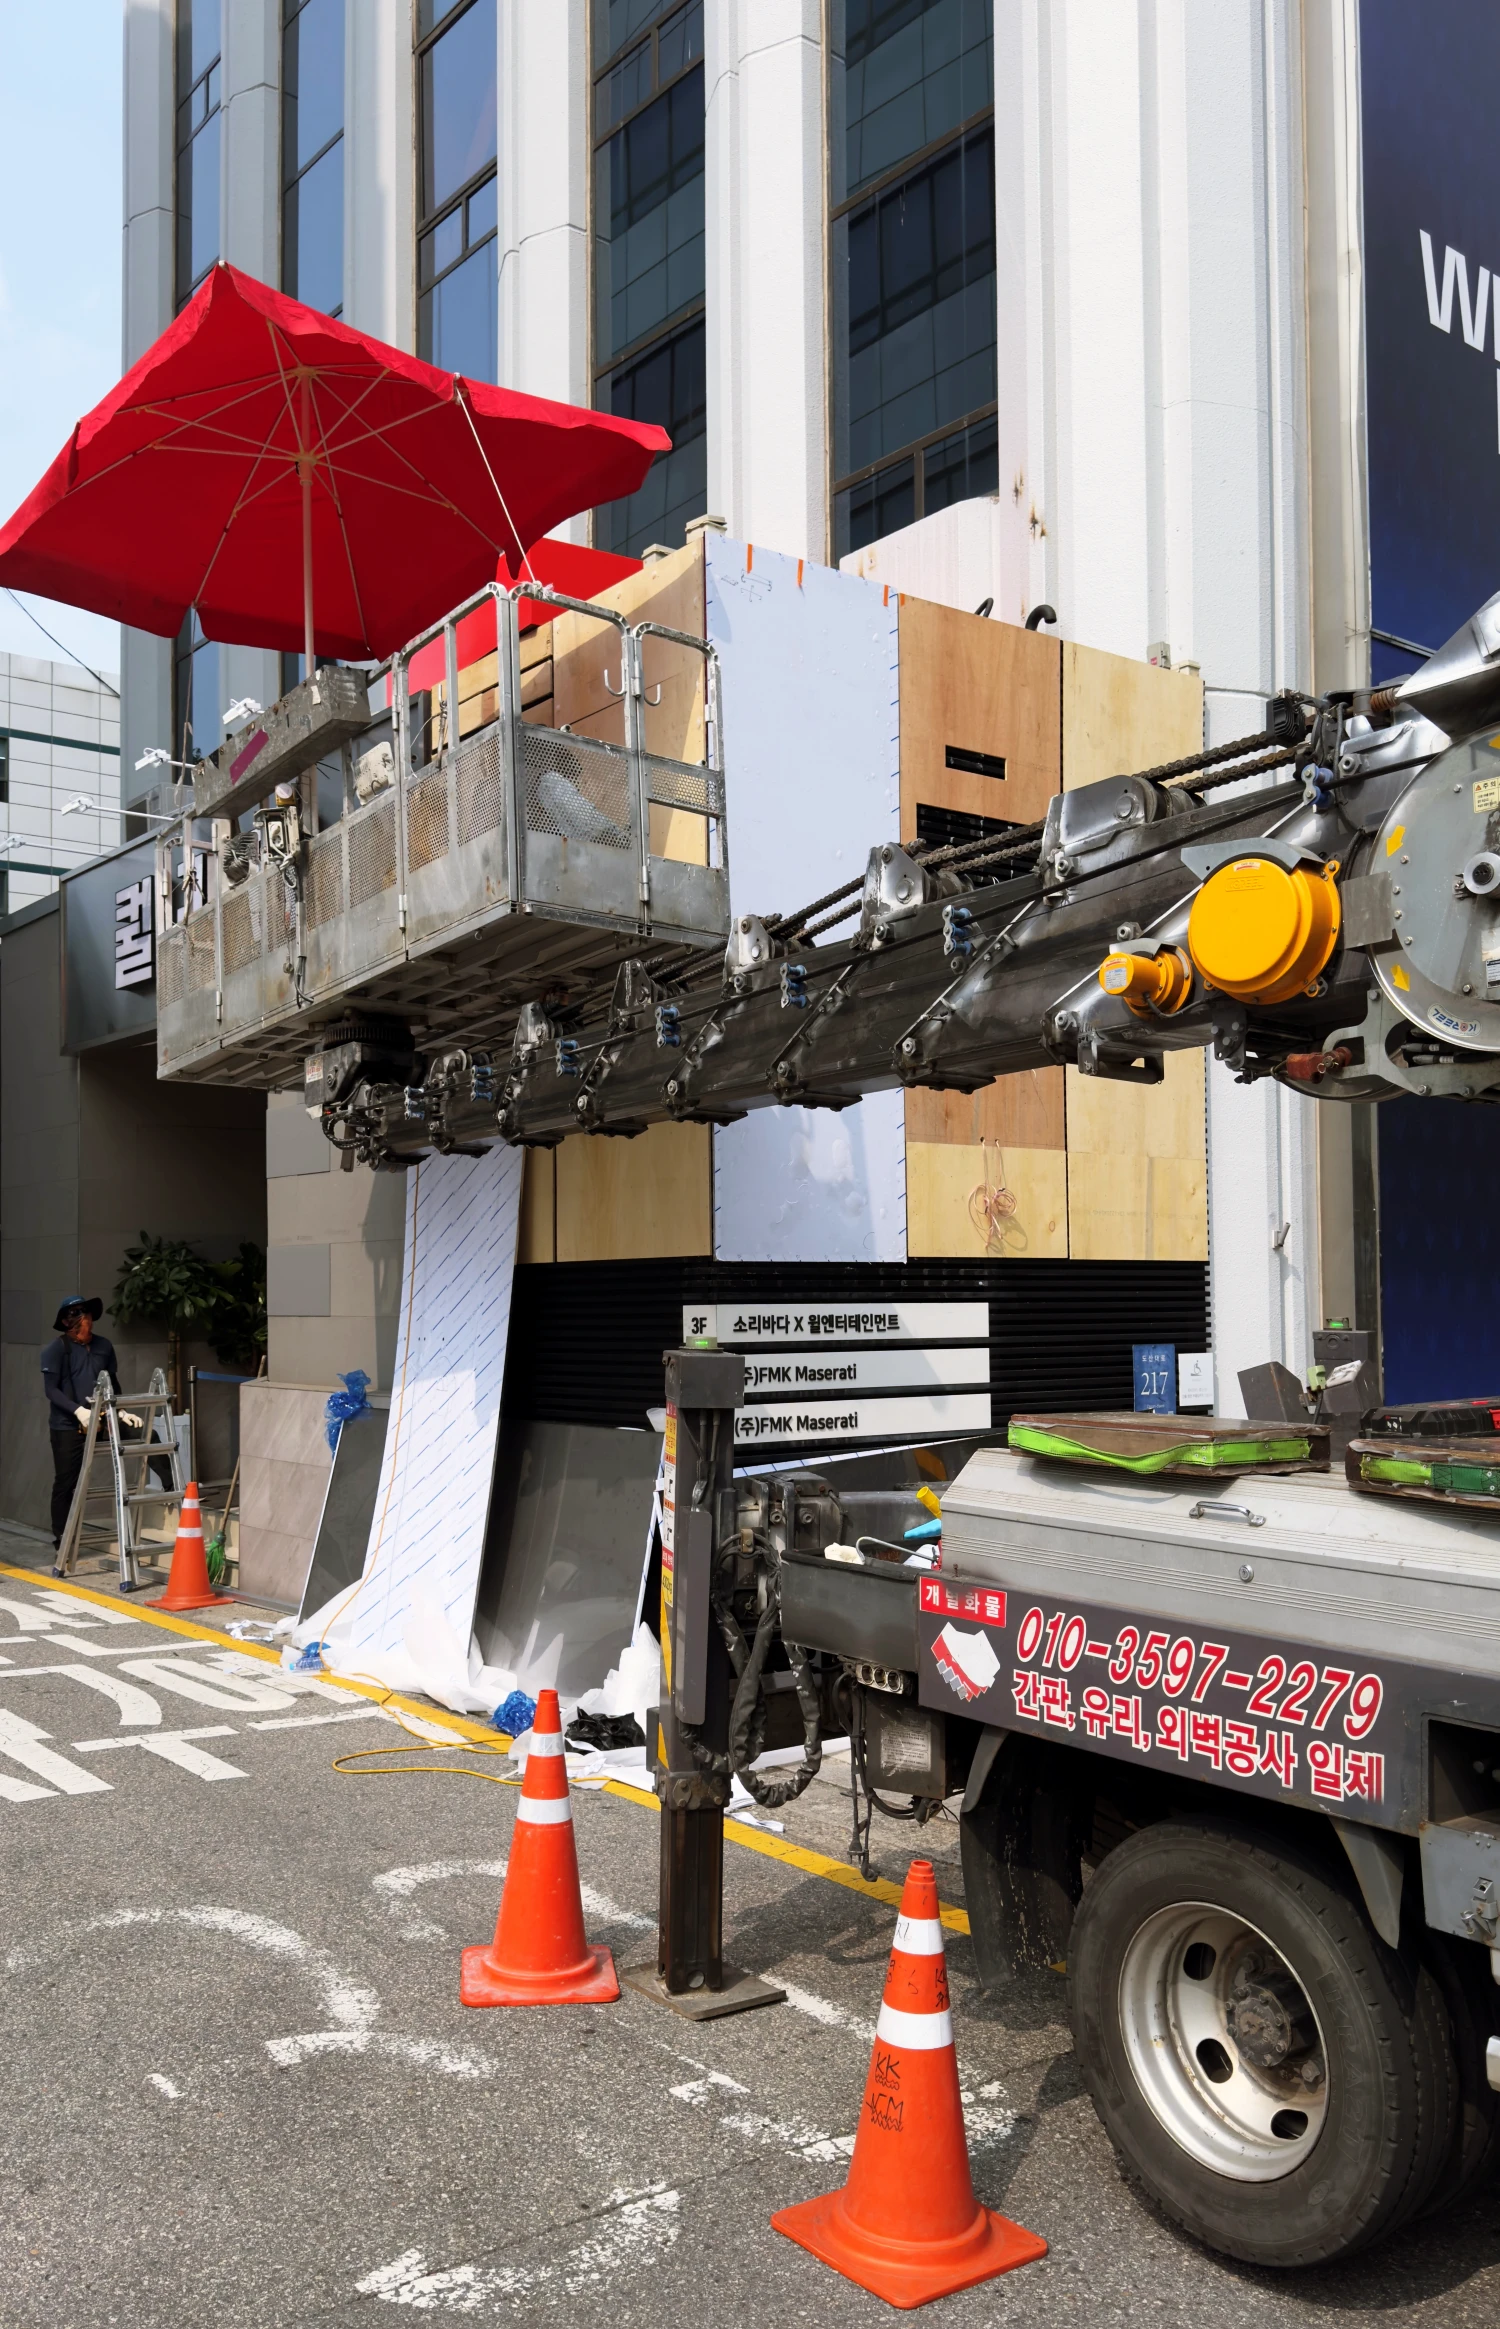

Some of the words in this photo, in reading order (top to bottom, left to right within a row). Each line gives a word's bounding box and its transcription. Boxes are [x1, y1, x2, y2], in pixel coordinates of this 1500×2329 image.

[691, 1317, 707, 1335] 3F
[733, 1314, 790, 1334] 소리바다
[794, 1316, 804, 1332] X
[807, 1313, 900, 1334] 윌엔터테인먼트
[744, 1366, 792, 1386] 주)FMK
[795, 1363, 857, 1381] Maserati
[1140, 1371, 1169, 1396] 217
[734, 1415, 793, 1437] (주)FMK
[796, 1411, 859, 1431] Maserati
[1016, 1606, 1385, 1741] 010-3597-2279
[1307, 1740, 1385, 1805] 일체
